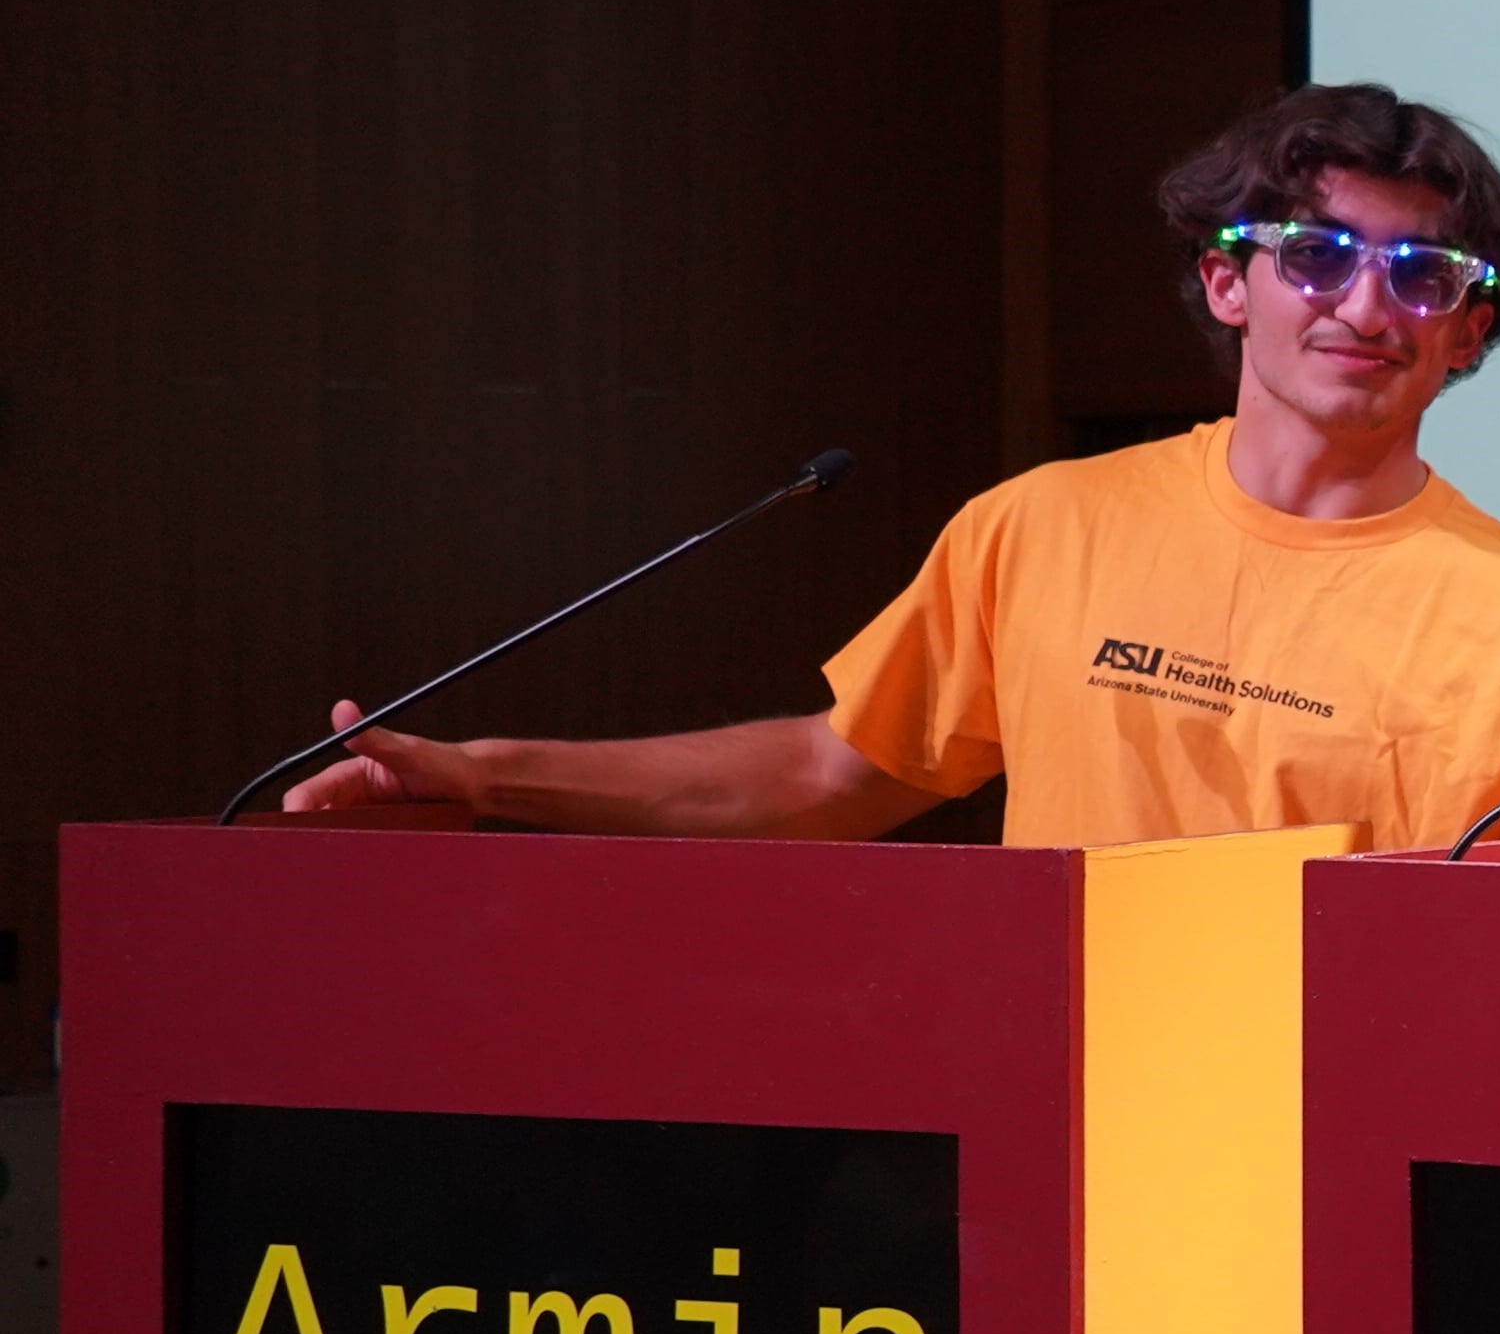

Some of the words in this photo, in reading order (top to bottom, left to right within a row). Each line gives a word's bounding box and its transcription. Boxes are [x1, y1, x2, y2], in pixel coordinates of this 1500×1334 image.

[1092, 638, 1164, 677] ASU
[1171, 651, 1215, 669] College
[1216, 662, 1230, 672] of
[1087, 675, 1132, 692] Arizona
[1134, 683, 1168, 699] State
[1170, 690, 1236, 717] University
[1165, 663, 1237, 695] Health
[1238, 680, 1335, 718] Solutions
